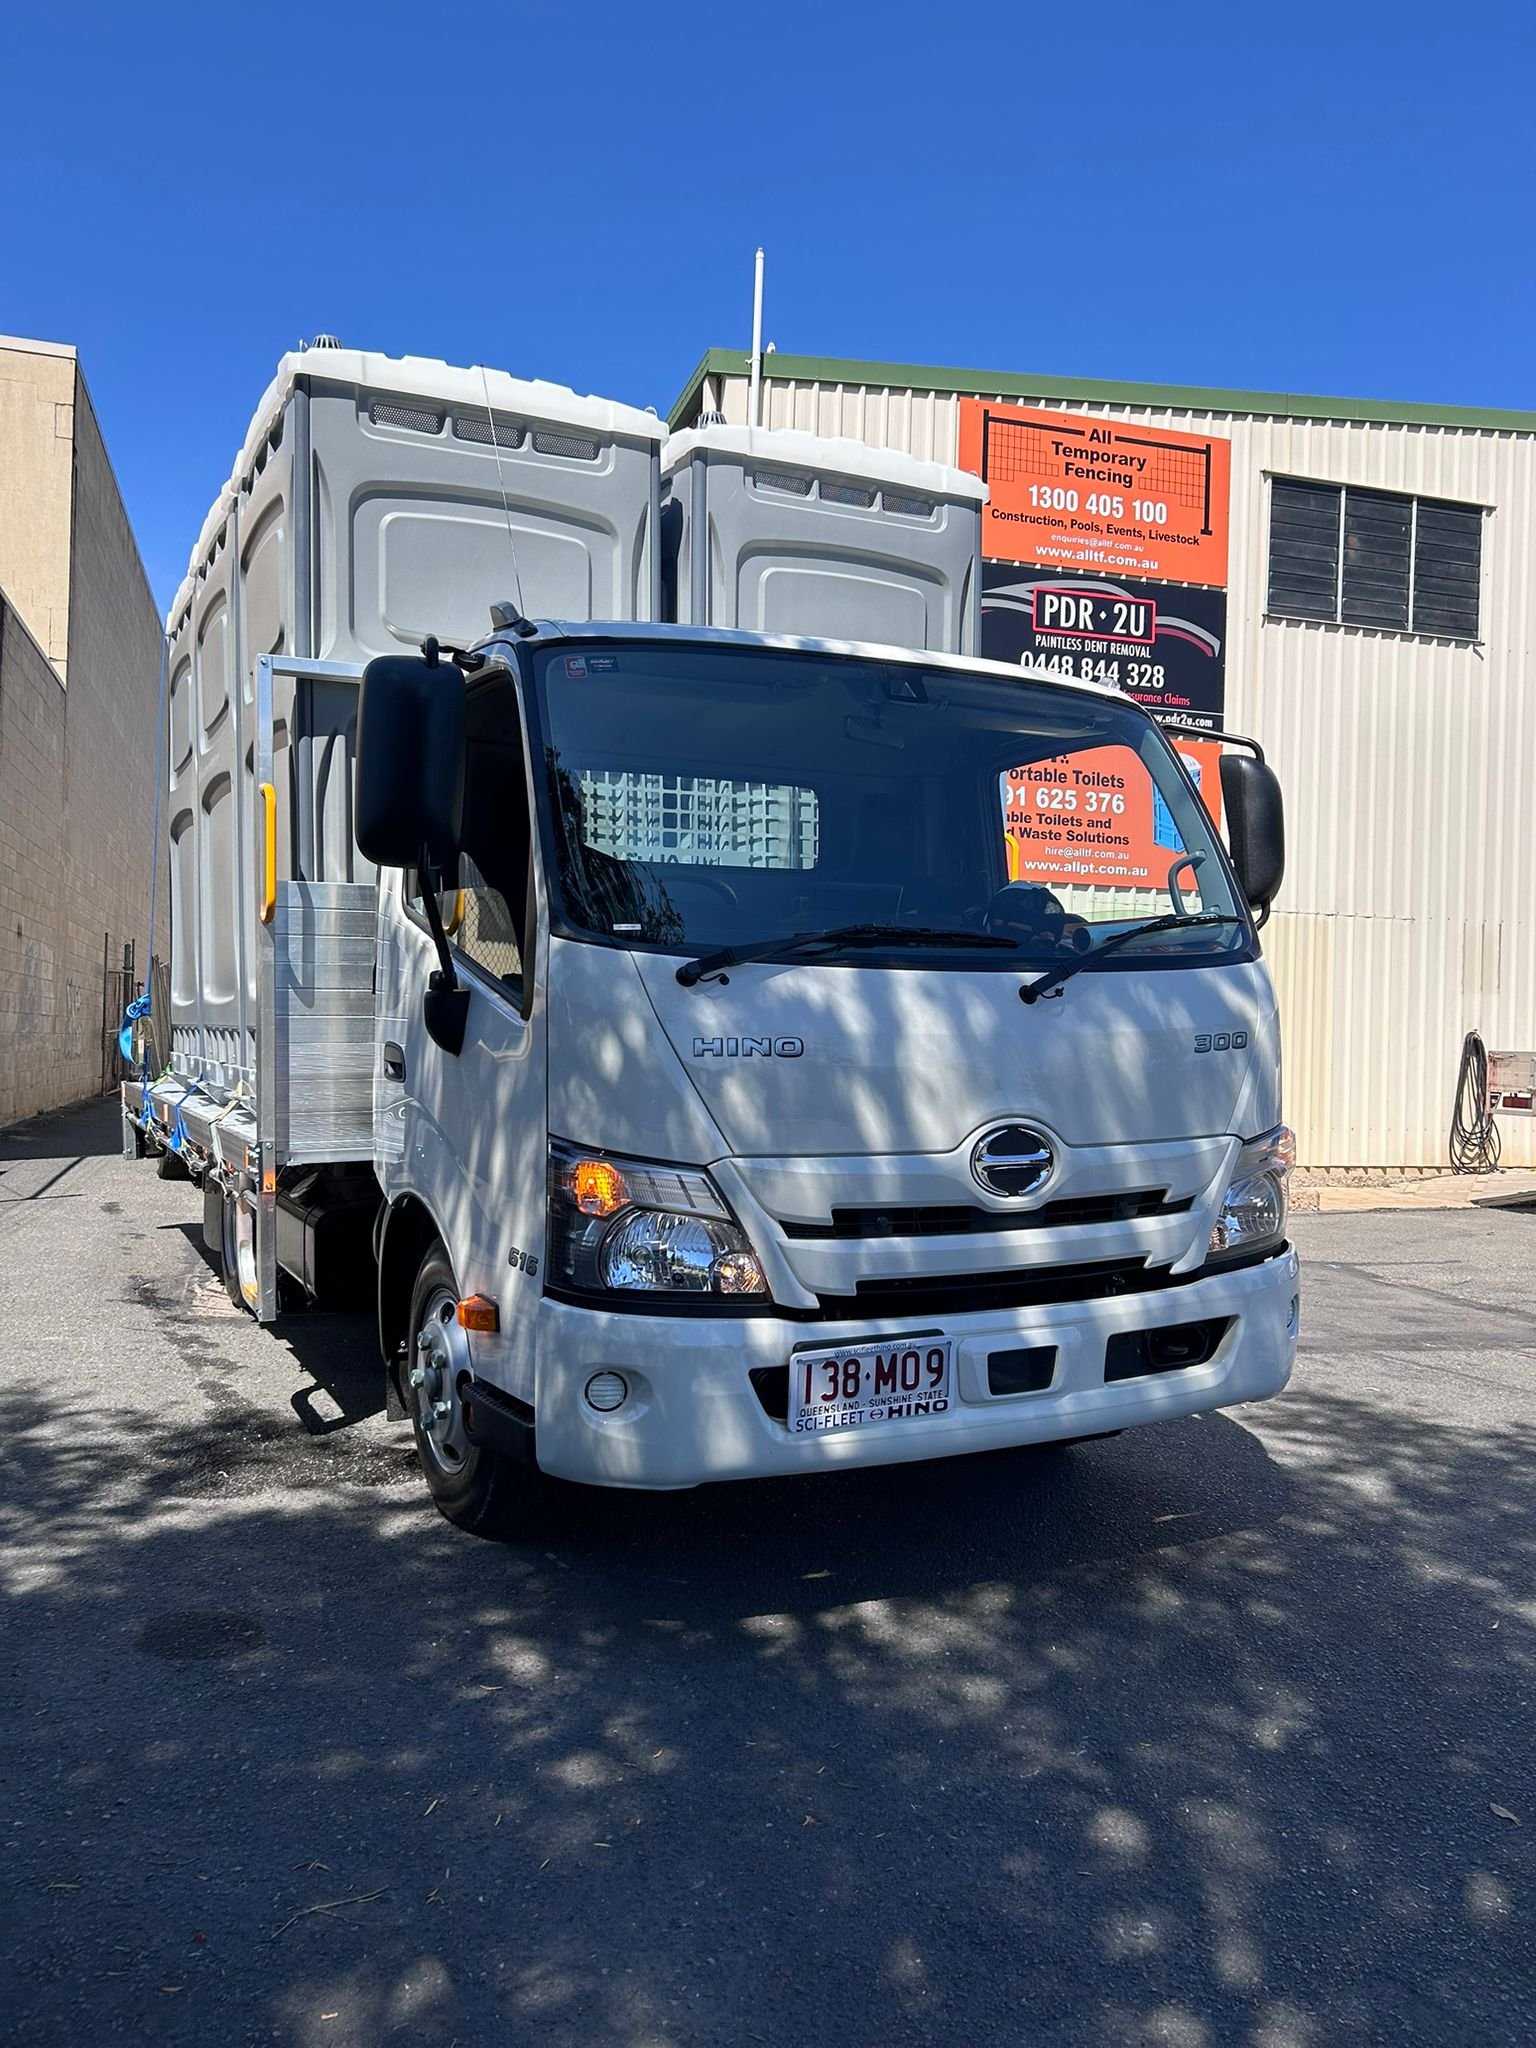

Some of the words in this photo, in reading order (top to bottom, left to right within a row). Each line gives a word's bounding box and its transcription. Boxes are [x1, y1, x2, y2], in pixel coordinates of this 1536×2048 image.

[1089, 428, 1112, 445] All
[1051, 441, 1147, 471] Temporary
[1064, 462, 1133, 488] Fencing
[1028, 484, 1079, 513] 1300
[1085, 493, 1124, 519] 405
[1132, 500, 1167, 525] 100
[991, 508, 1068, 530] Construction,
[1070, 519, 1103, 535] Pools,
[1106, 524, 1145, 541] Events,
[1148, 530, 1200, 546] Livestock
[1051, 533, 1144, 553] enquiries@alltf.com.au
[1035, 544, 1159, 570] www.alltf.com.au
[1035, 635, 1082, 652] PAINTLESS
[1085, 639, 1109, 654] DENT
[1110, 642, 1152, 658] REMOVAL
[1020, 650, 1074, 677] 0448
[1080, 657, 1119, 682] 844
[1126, 662, 1165, 689] 328
[1164, 692, 1191, 706] Claims
[1006, 766, 1068, 784] ortable
[1072, 769, 1125, 789] Toilets
[1035, 787, 1078, 811] 625
[1085, 792, 1126, 815] 376
[1036, 812, 1083, 828] Toilets
[1086, 817, 1112, 830] and
[1019, 826, 1062, 841] Waste
[1066, 829, 1130, 846] Solutions
[1044, 845, 1130, 860] hire@alltf.com.au
[1024, 858, 1148, 877] www.allpt.com.au
[692, 1036, 804, 1058] HINO
[1193, 1031, 1248, 1054] 300
[508, 1246, 539, 1277] 616
[800, 1401, 860, 1418] QUEENSLAND
[869, 1393, 913, 1408] SUNSHINE
[917, 1389, 943, 1401] STATE
[796, 1410, 866, 1433] SCI-FLEET
[887, 1399, 949, 1419] HINO
